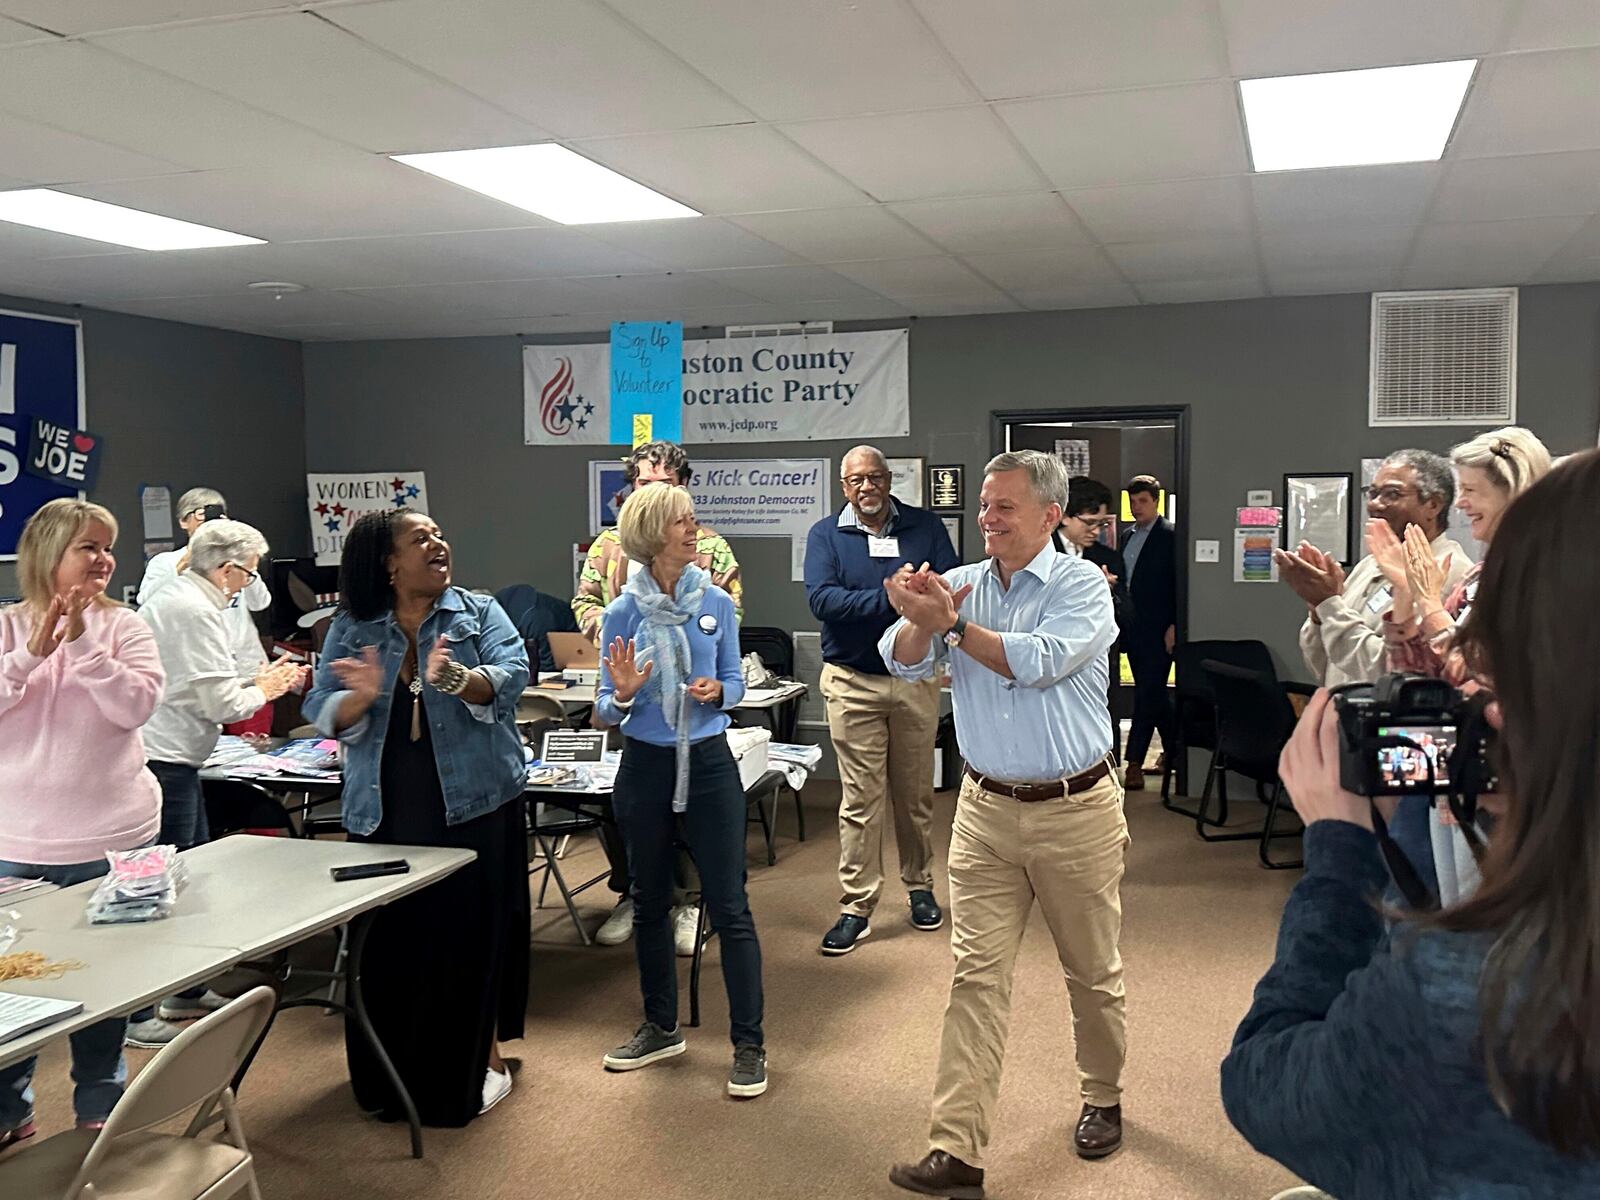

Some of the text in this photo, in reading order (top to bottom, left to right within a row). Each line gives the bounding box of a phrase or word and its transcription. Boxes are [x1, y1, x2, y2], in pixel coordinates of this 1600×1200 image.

[650, 326, 670, 353] Up
[639, 350, 652, 368] to
[751, 347, 855, 375] County
[614, 370, 674, 395] Volunteer
[783, 378, 861, 406] Party
[37, 419, 70, 449] WE
[699, 418, 778, 432] www.jcdp.org
[34, 442, 89, 481] JOE
[706, 469, 743, 486] Kick
[748, 468, 818, 486] Cancer!
[316, 480, 388, 500] WOMEN
[709, 494, 756, 505] Johnston
[758, 494, 816, 505] Democrats
